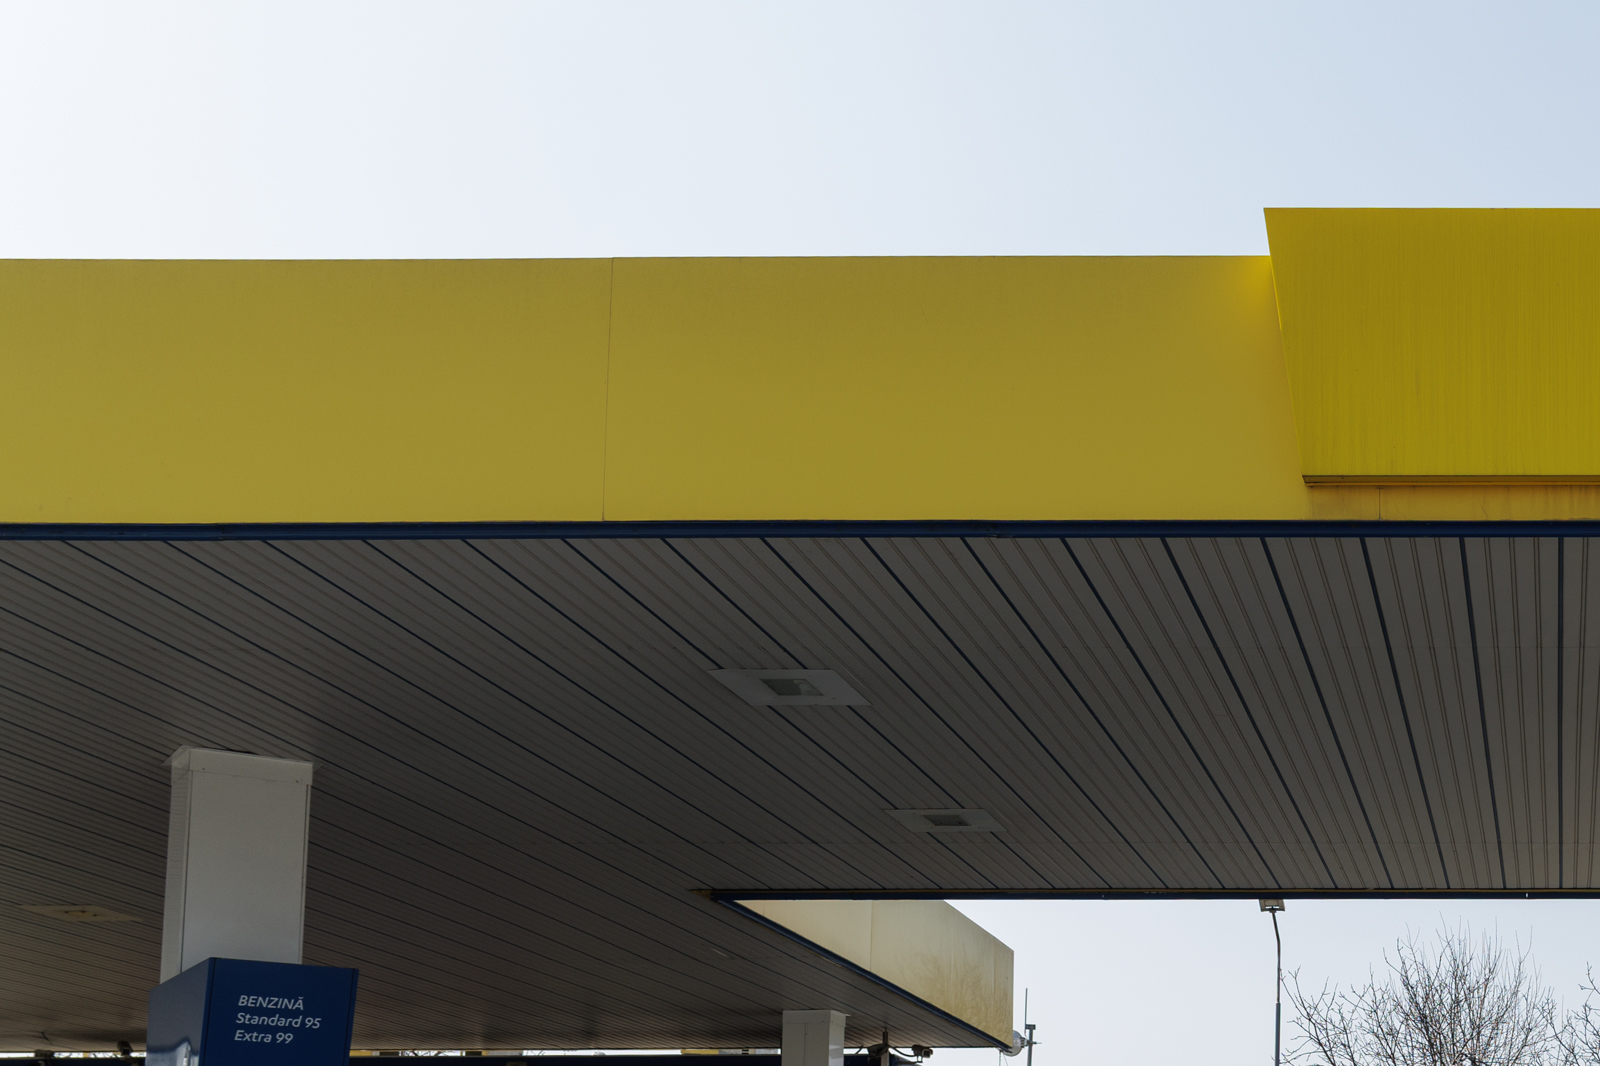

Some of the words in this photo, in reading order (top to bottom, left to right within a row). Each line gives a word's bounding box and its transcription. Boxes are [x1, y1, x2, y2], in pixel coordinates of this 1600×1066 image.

[238, 995, 304, 1011] BENZINĂ
[236, 1012, 302, 1028] Standard
[305, 1017, 321, 1029] 95
[234, 1030, 272, 1043] Extra
[275, 1032, 294, 1044] 99
